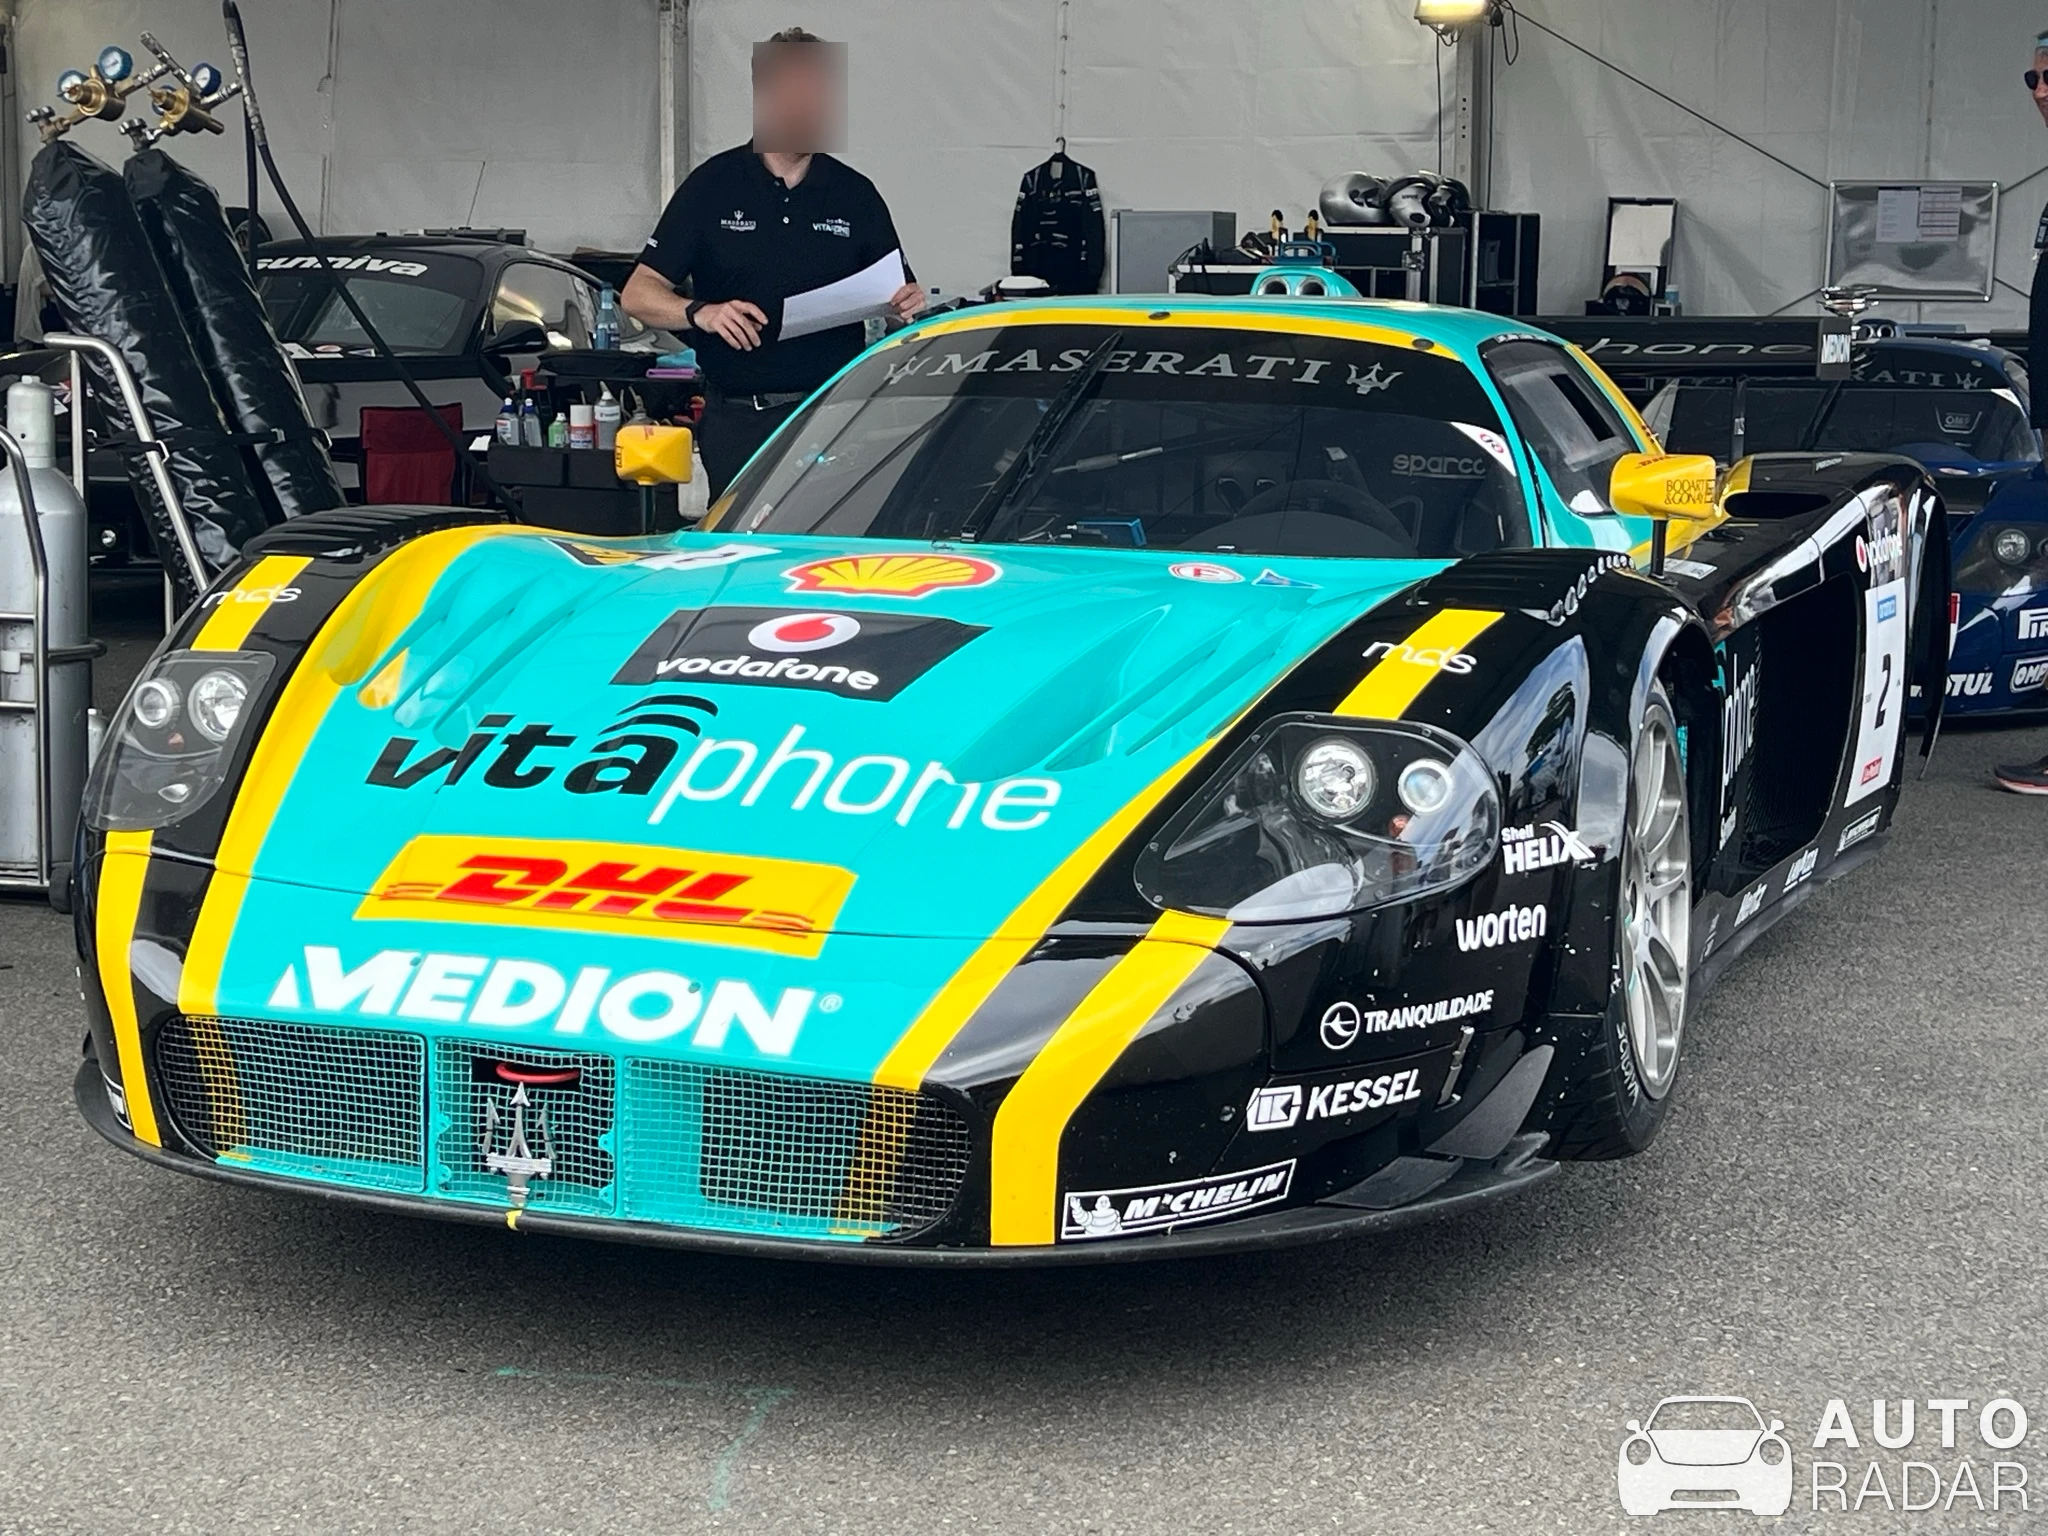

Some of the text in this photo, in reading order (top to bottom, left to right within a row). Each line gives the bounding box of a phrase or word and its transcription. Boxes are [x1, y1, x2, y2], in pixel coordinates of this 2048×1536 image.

[926, 348, 1332, 384] MASERATI
[1572, 338, 1813, 355] hone
[201, 584, 302, 609] mds
[656, 656, 880, 691] vodafone
[1362, 641, 1478, 674] mds
[1874, 653, 1891, 731] 2
[365, 702, 1062, 832] vitaphone
[1501, 823, 1534, 843] Shell
[1502, 820, 1596, 875] HELIX
[435, 854, 756, 923] DHL
[1455, 903, 1547, 952] worten
[267, 944, 818, 1057] MEDION
[1363, 989, 1495, 1034] TRANQUILIDADE
[1305, 1068, 1422, 1121] KESSEL
